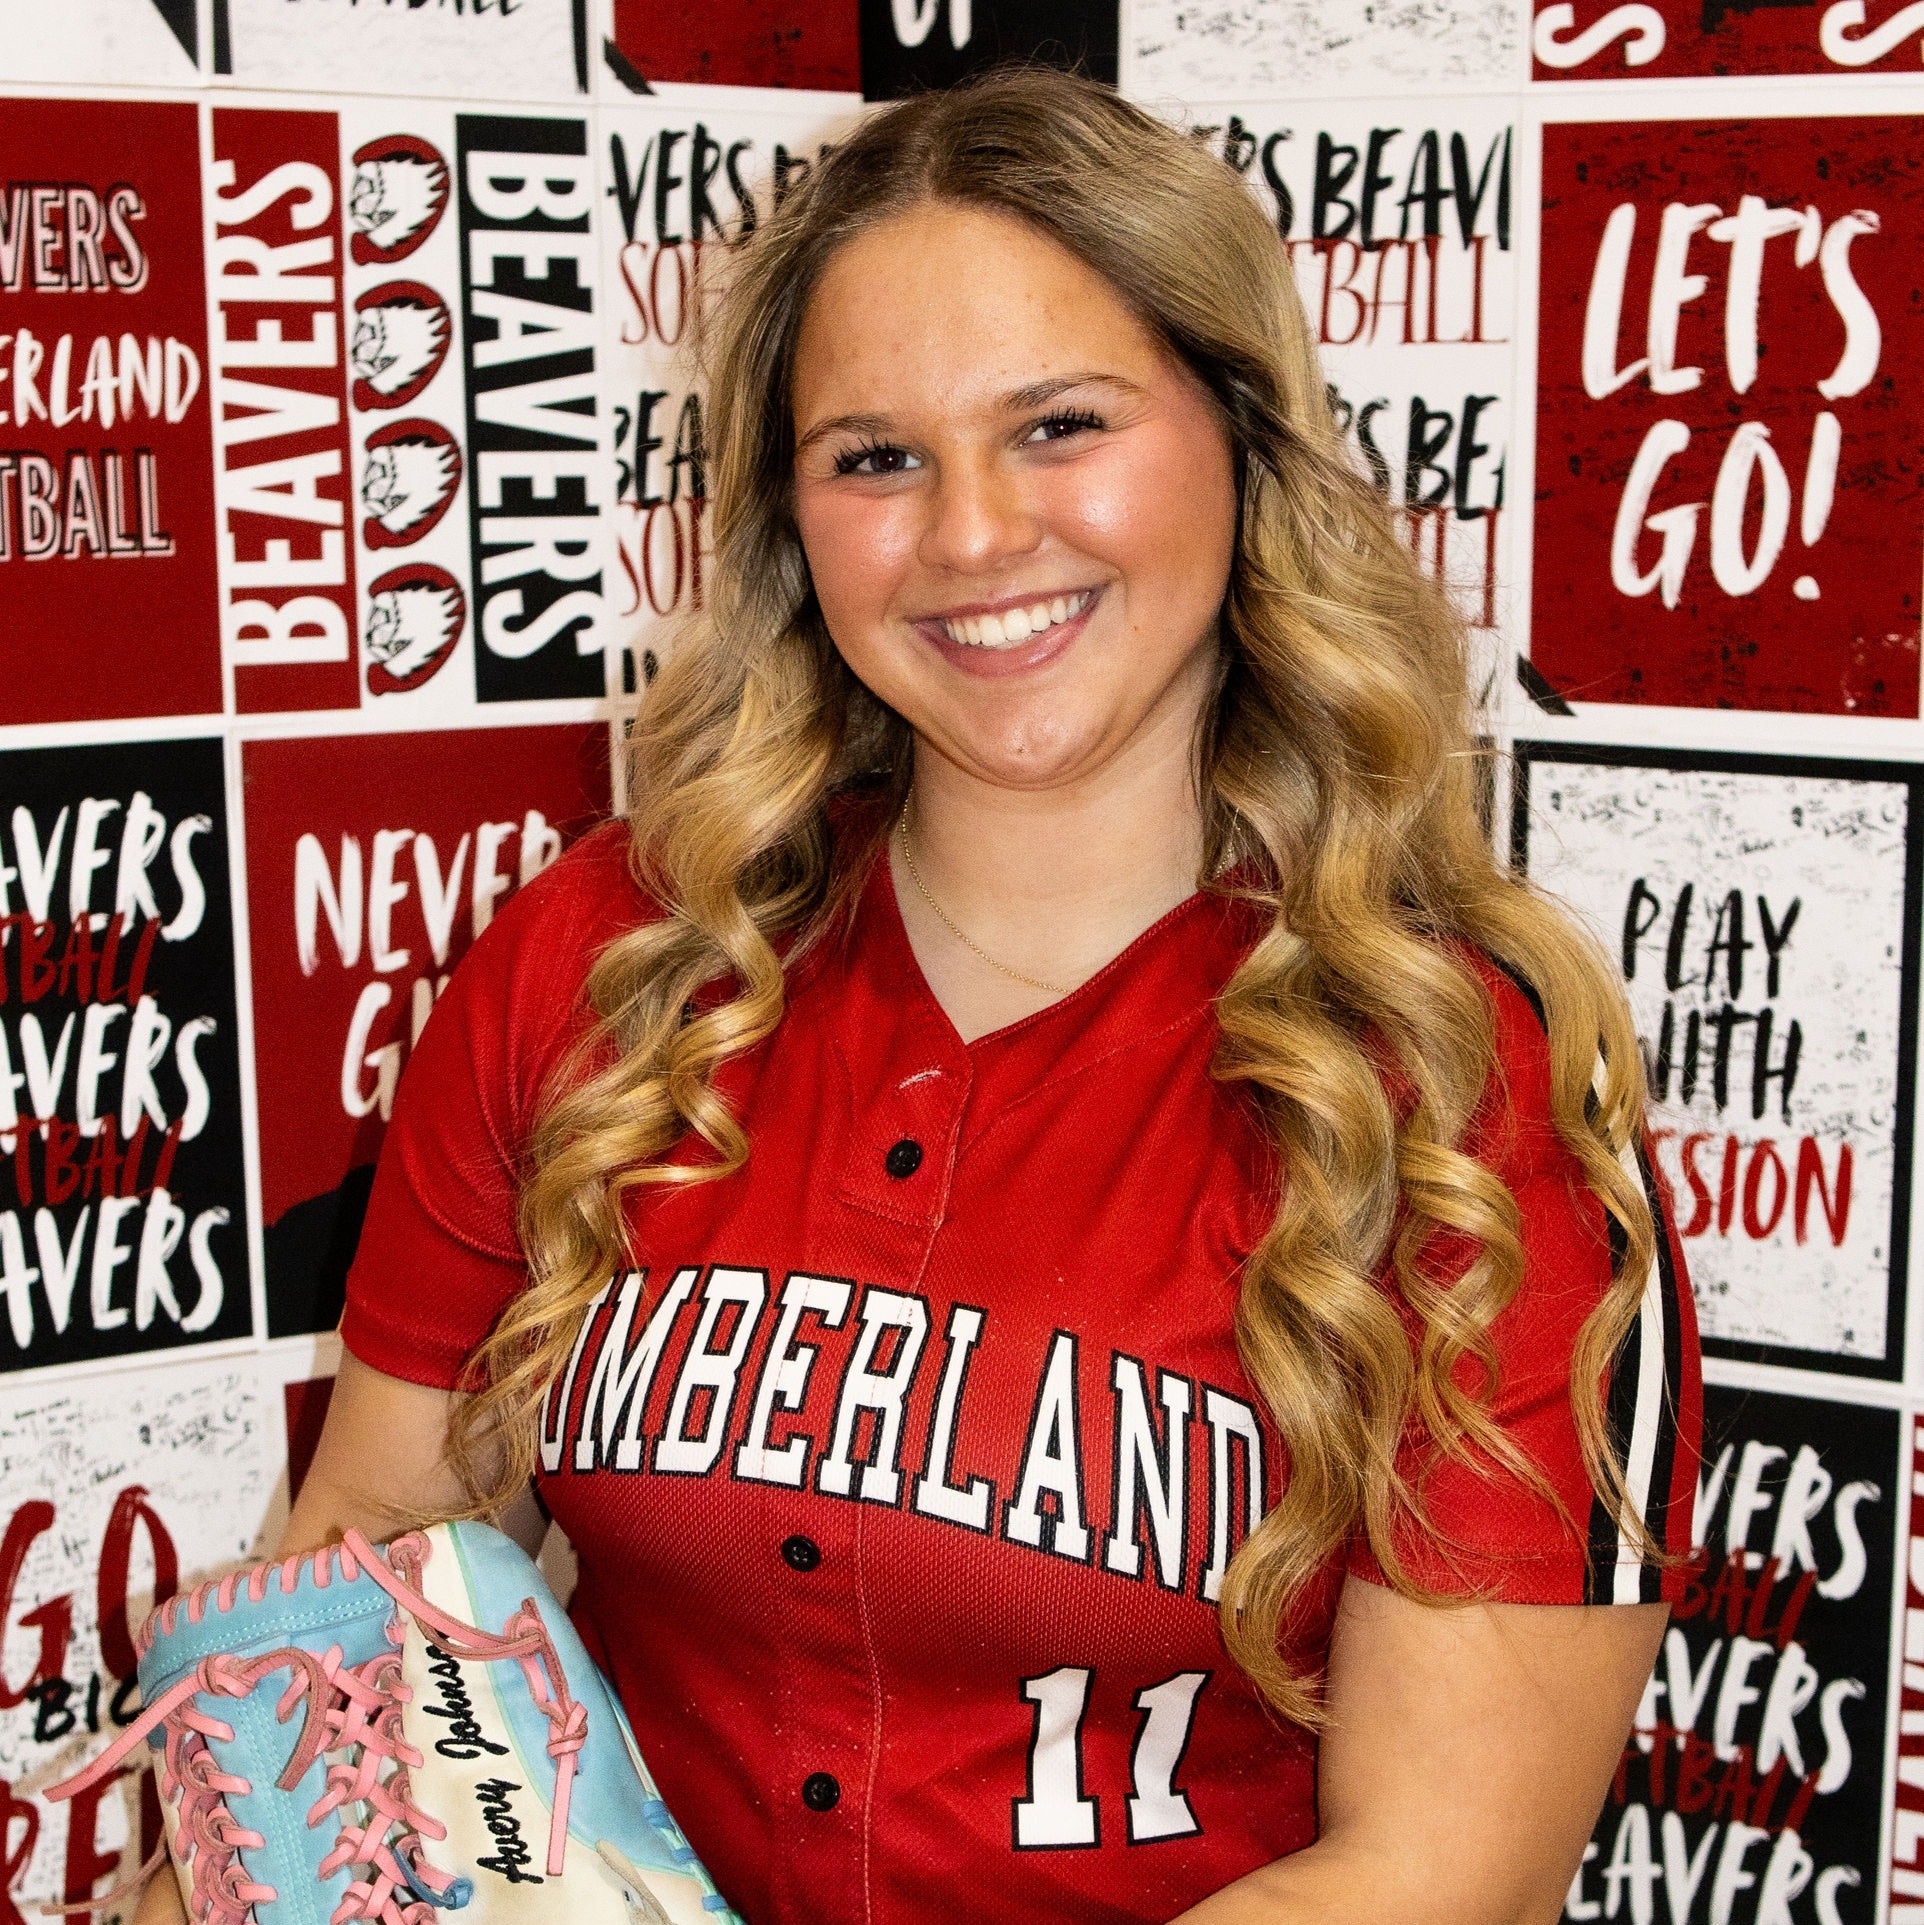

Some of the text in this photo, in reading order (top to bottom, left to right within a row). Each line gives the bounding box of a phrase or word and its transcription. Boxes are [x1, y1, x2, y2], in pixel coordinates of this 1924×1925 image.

[1581, 195, 1883, 401] LET'S
[213, 160, 350, 666] BEAVERS
[465, 150, 606, 659] BEAVERS
[1404, 394, 1505, 520] BE
[1610, 411, 1842, 611] GO!
[1622, 878, 1801, 1001] PLAY
[0, 1484, 179, 1710] GO
[474, 1777, 545, 1885] Avery
[1012, 1664, 1214, 1853] 11
